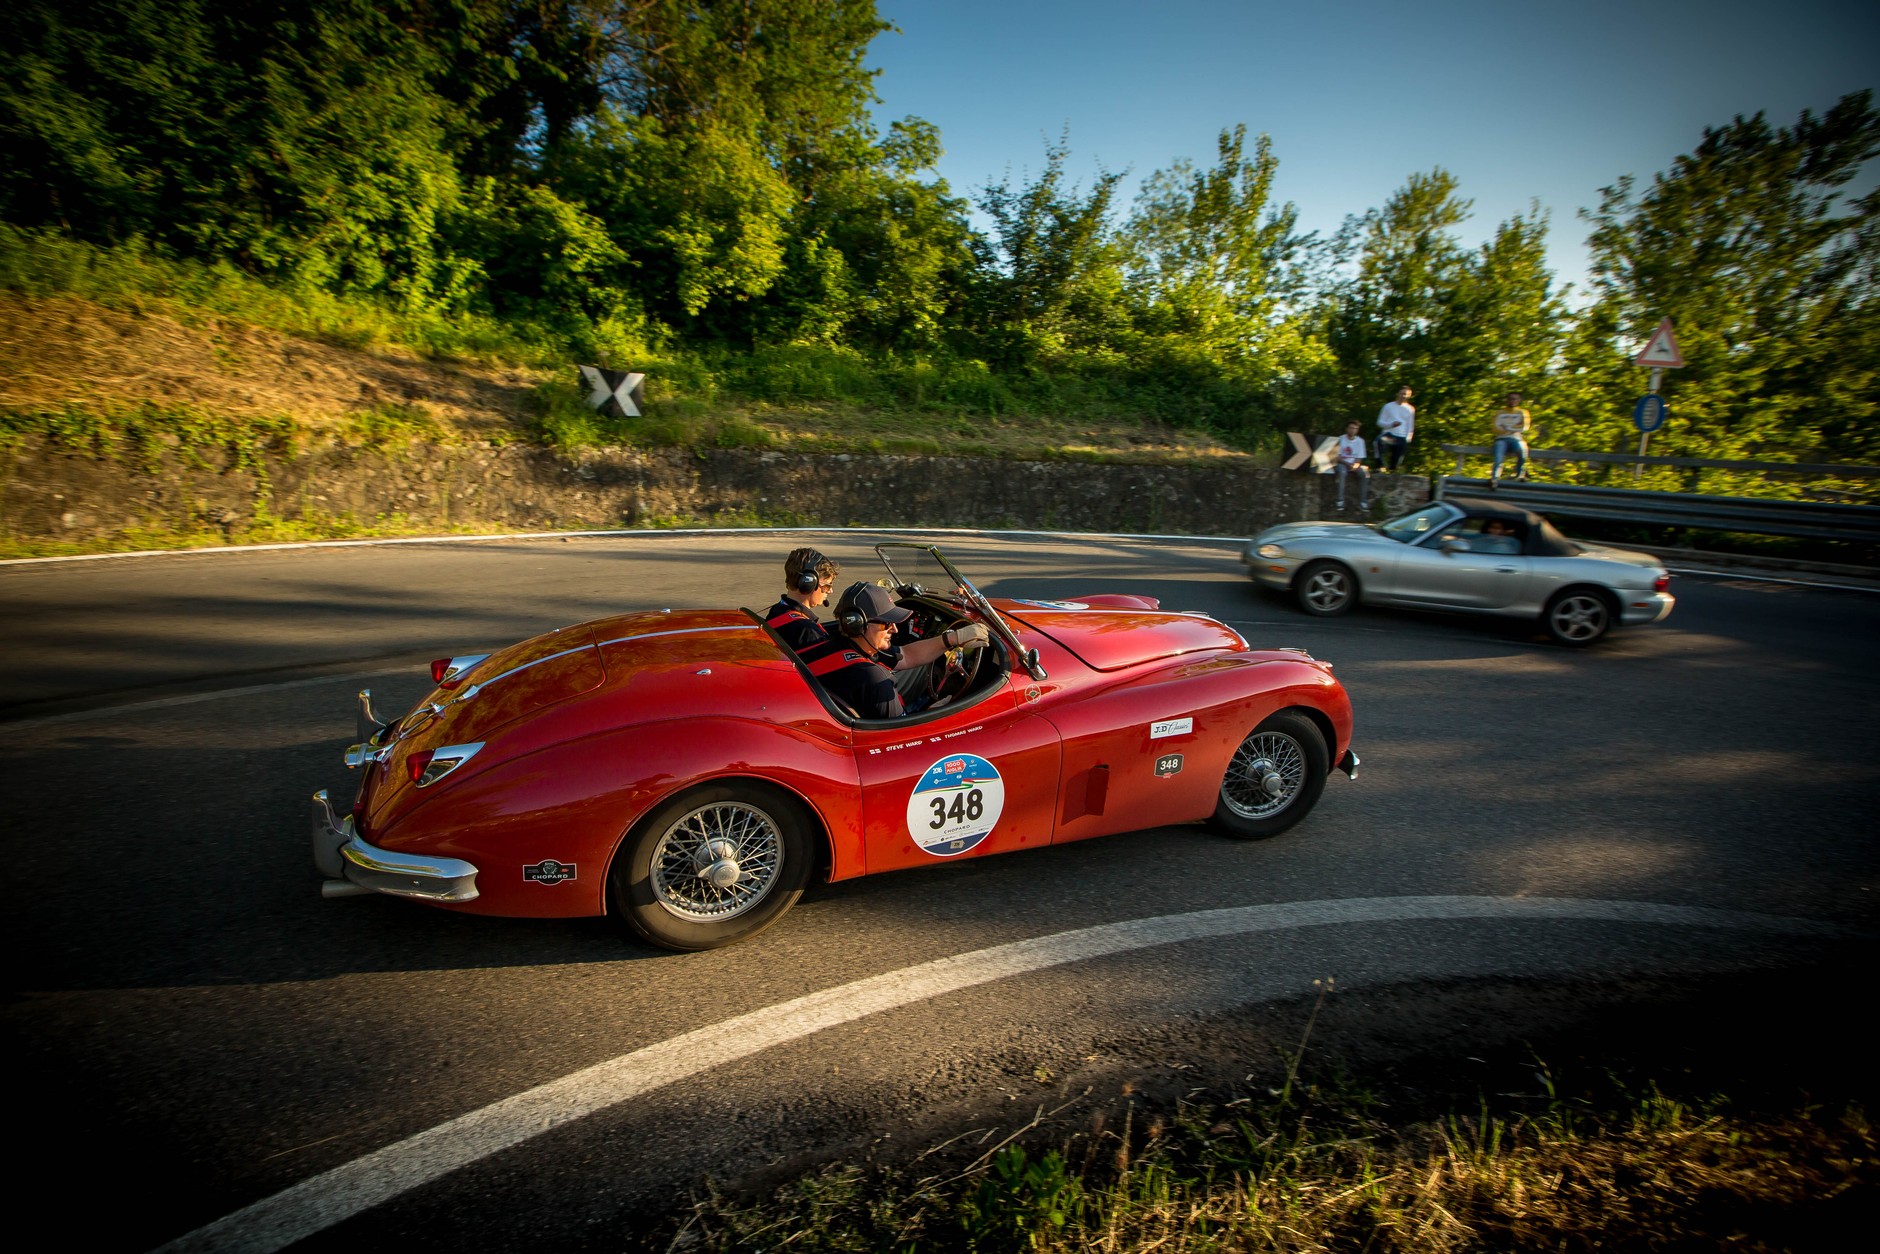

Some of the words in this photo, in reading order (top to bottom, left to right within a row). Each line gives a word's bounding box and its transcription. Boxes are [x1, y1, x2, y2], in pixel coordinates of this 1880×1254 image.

[944, 730, 966, 739] THOMAS
[967, 725, 983, 733] WARD
[886, 743, 904, 752] STEVE
[905, 740, 923, 748] WARD
[1160, 758, 1178, 770] 348
[929, 788, 983, 830] 348
[943, 824, 971, 834] CHOPARD
